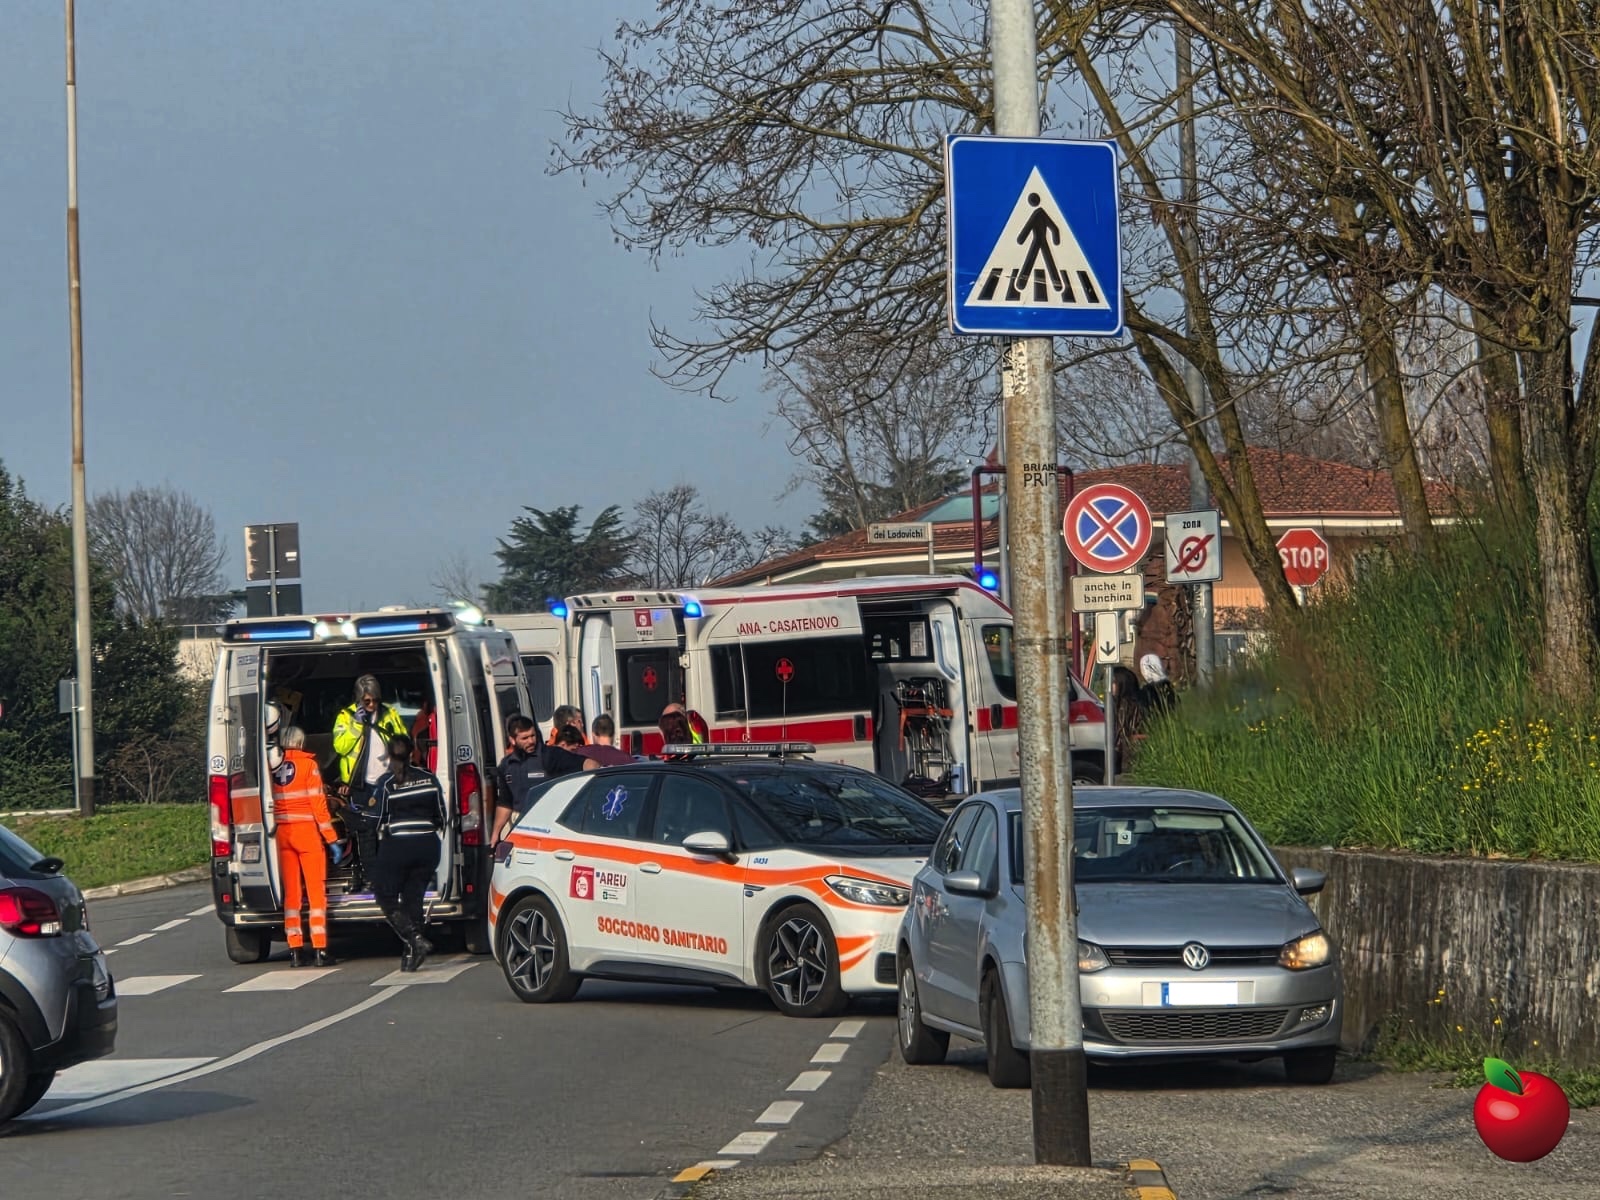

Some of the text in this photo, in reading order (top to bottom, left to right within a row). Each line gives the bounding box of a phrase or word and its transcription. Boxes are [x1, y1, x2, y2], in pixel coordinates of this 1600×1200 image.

[874, 528, 923, 539] dei Lodovichi
[1278, 546, 1325, 568] STOP
[1084, 581, 1116, 592] anche
[1083, 593, 1132, 604] banchina
[737, 621, 762, 635] ANA
[769, 616, 840, 633] CASATENOVO
[600, 871, 627, 888] AREU
[597, 915, 728, 955] SOCCORSO SANITARIO
